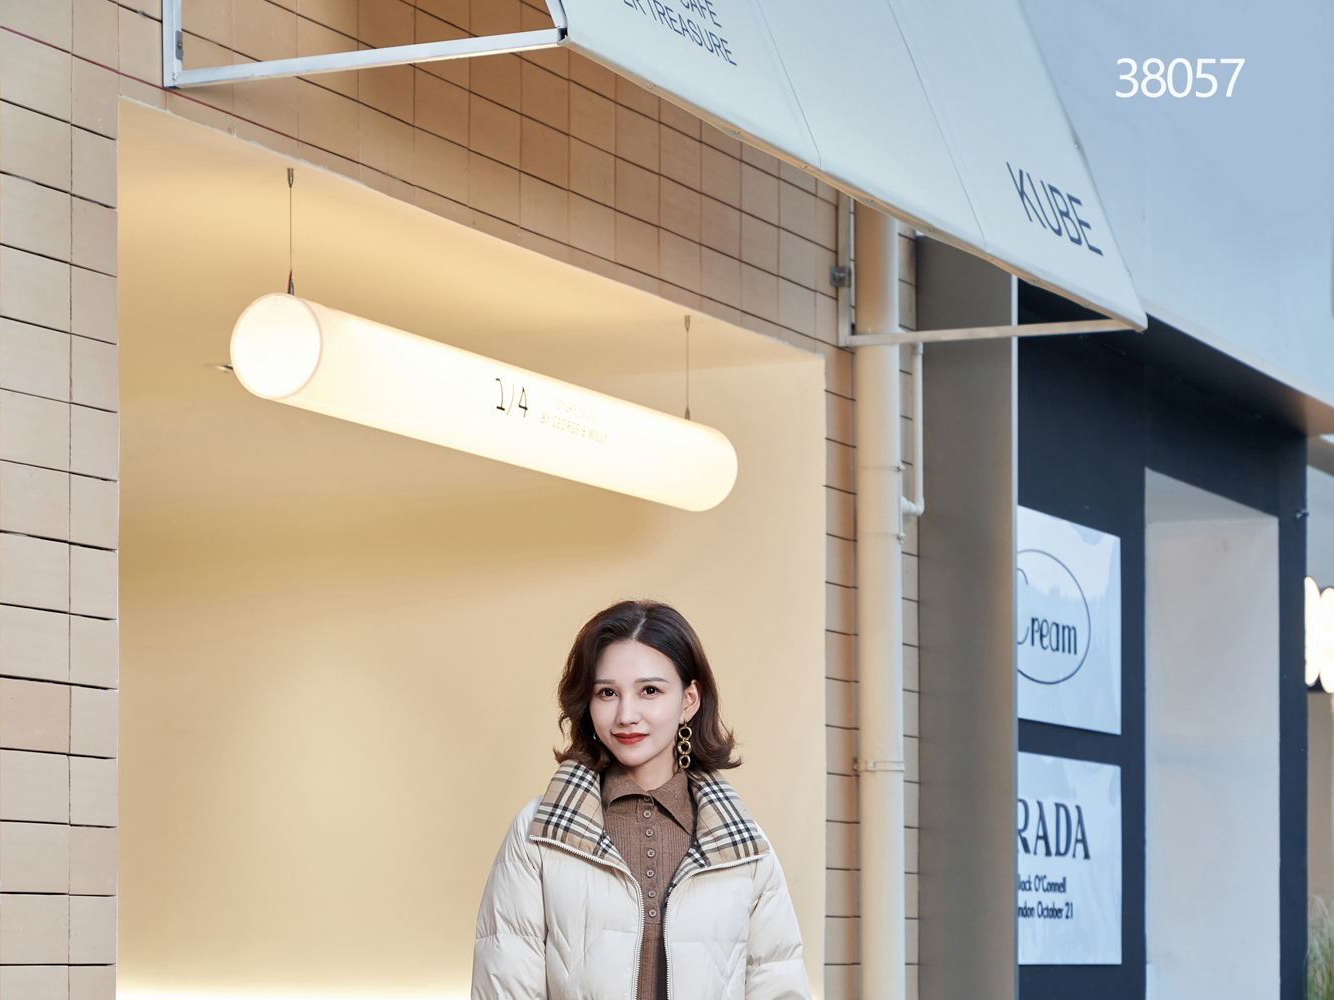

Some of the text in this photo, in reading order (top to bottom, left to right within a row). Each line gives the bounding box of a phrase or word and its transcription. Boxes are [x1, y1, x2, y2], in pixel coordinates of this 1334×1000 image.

[1005, 161, 1104, 257] KUBE
[552, 415, 580, 435] GEORGE
[1037, 900, 1064, 919] October
[1065, 901, 1074, 920] 21
